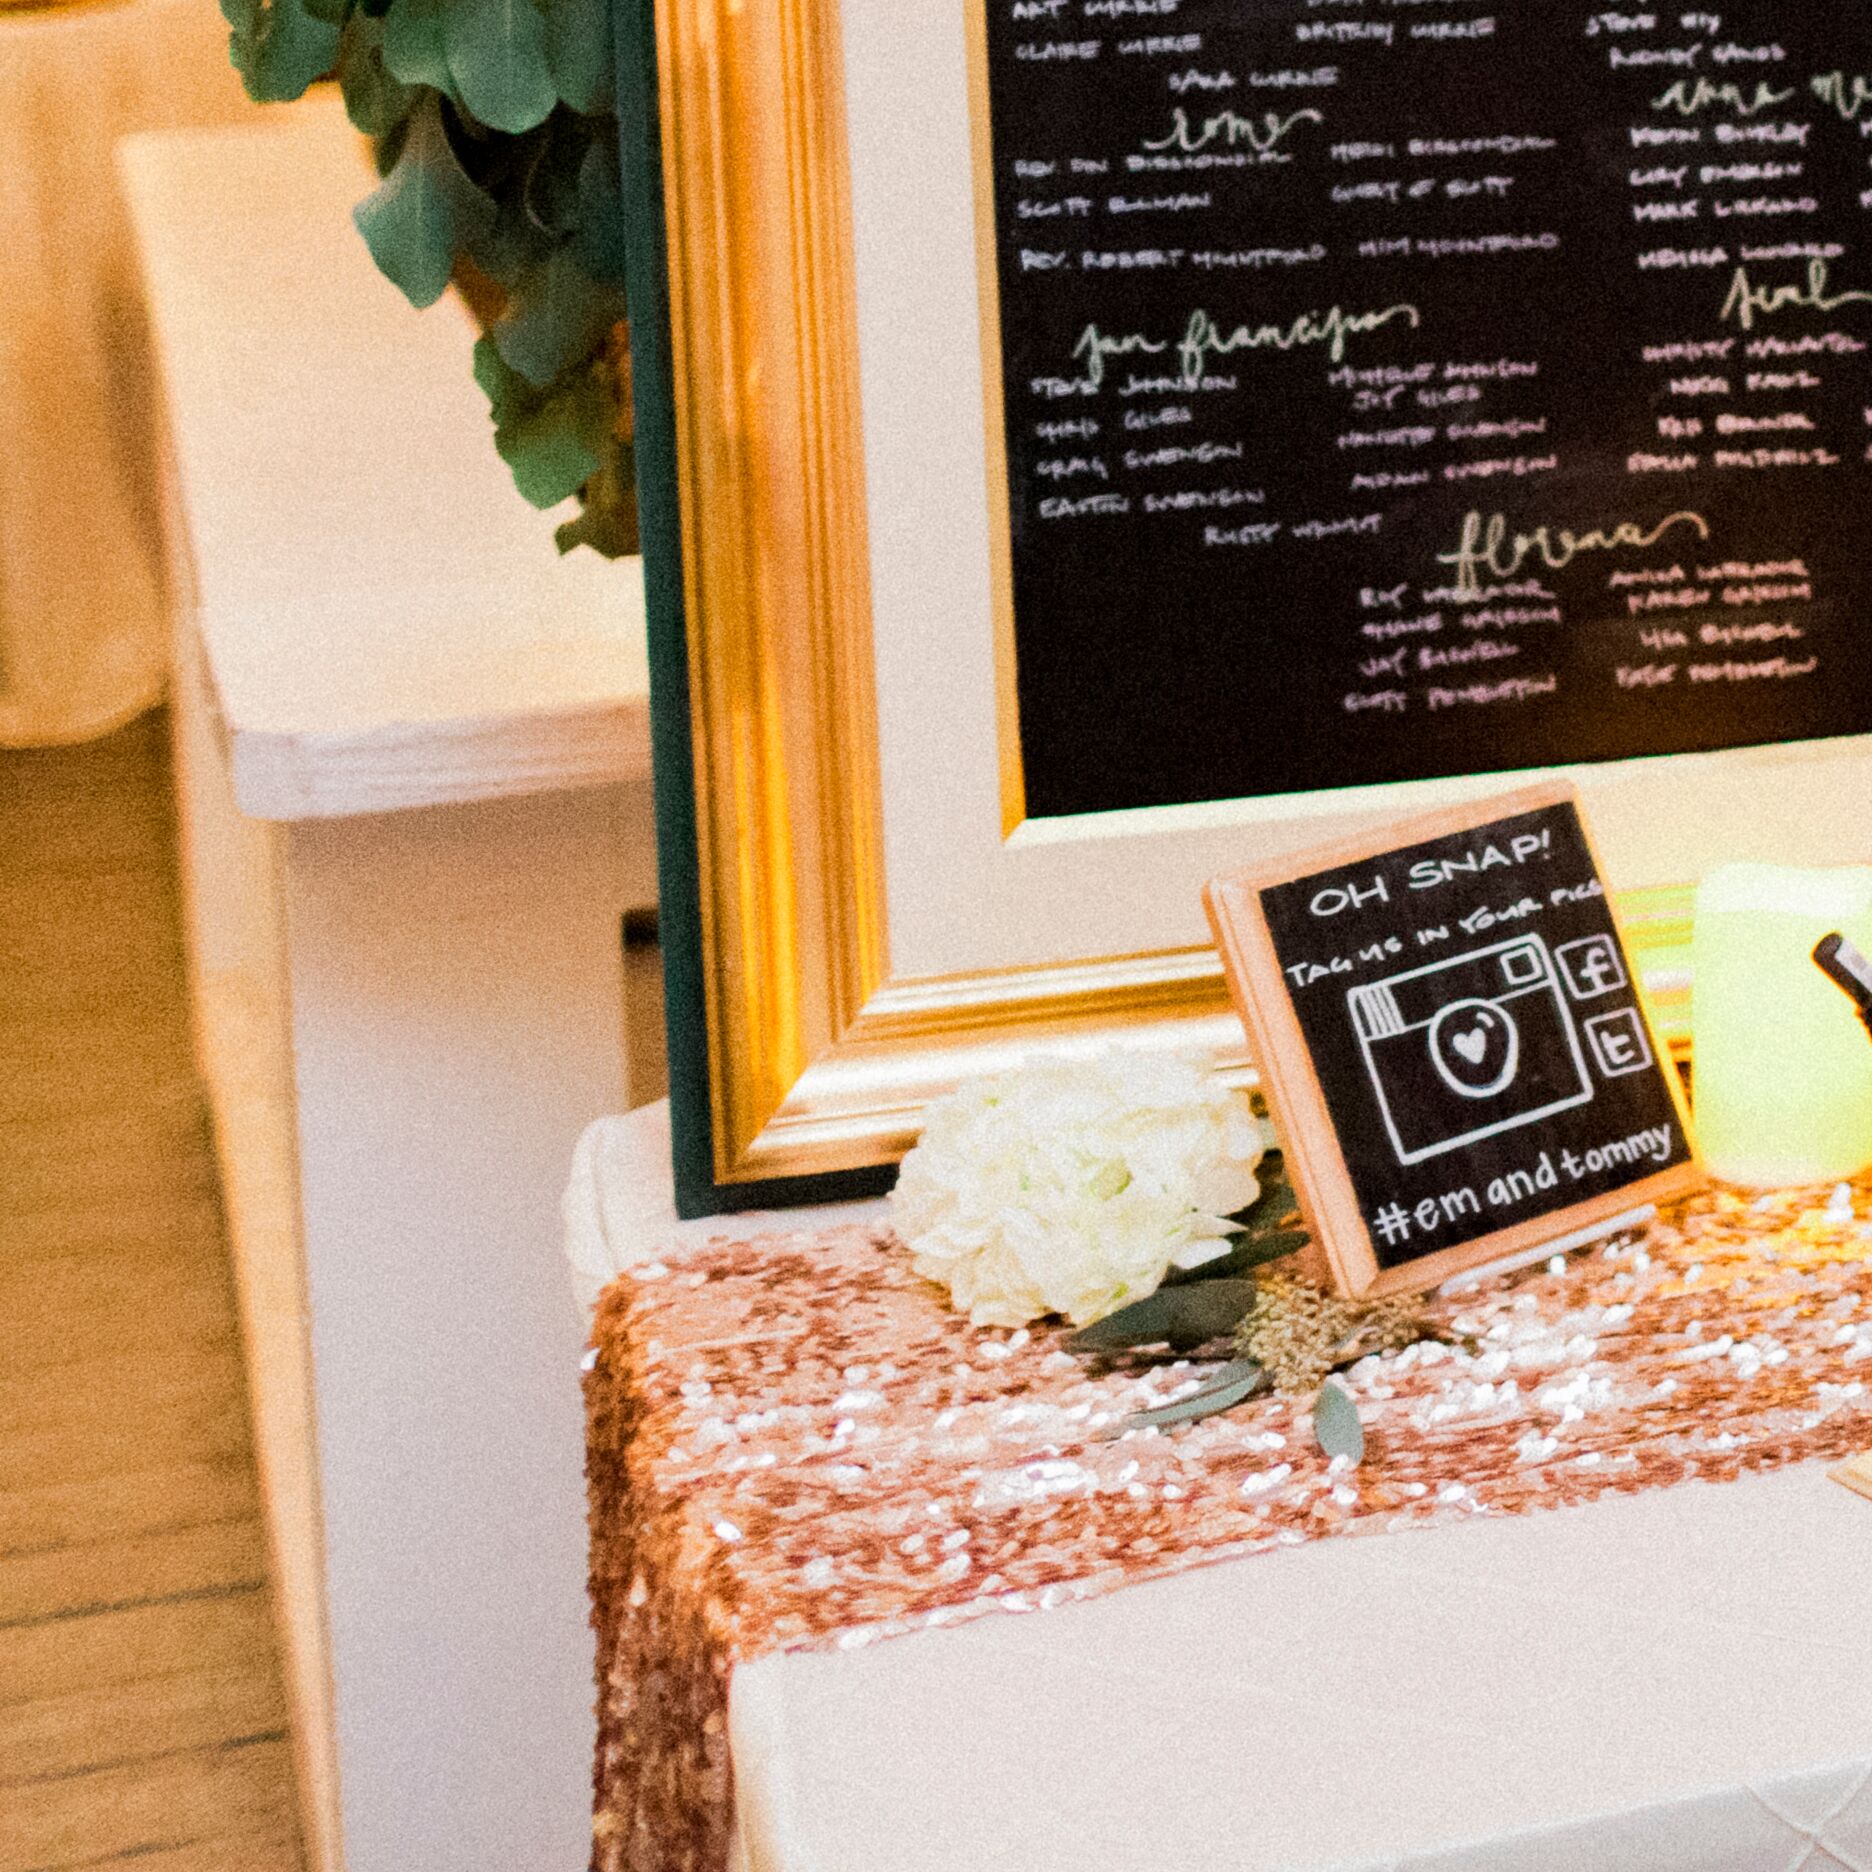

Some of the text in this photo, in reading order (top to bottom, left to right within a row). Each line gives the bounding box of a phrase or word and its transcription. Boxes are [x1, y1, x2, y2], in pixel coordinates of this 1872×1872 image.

[1015, 40, 1101, 61] CLAIRE
[1141, 106, 1323, 151] rome
[1017, 196, 1092, 219] SCOTT
[1082, 249, 1183, 269] ROBERT
[1309, 829, 1551, 918] OH SNAP!
[1287, 879, 1604, 988] TAG US IN YOUR PICS
